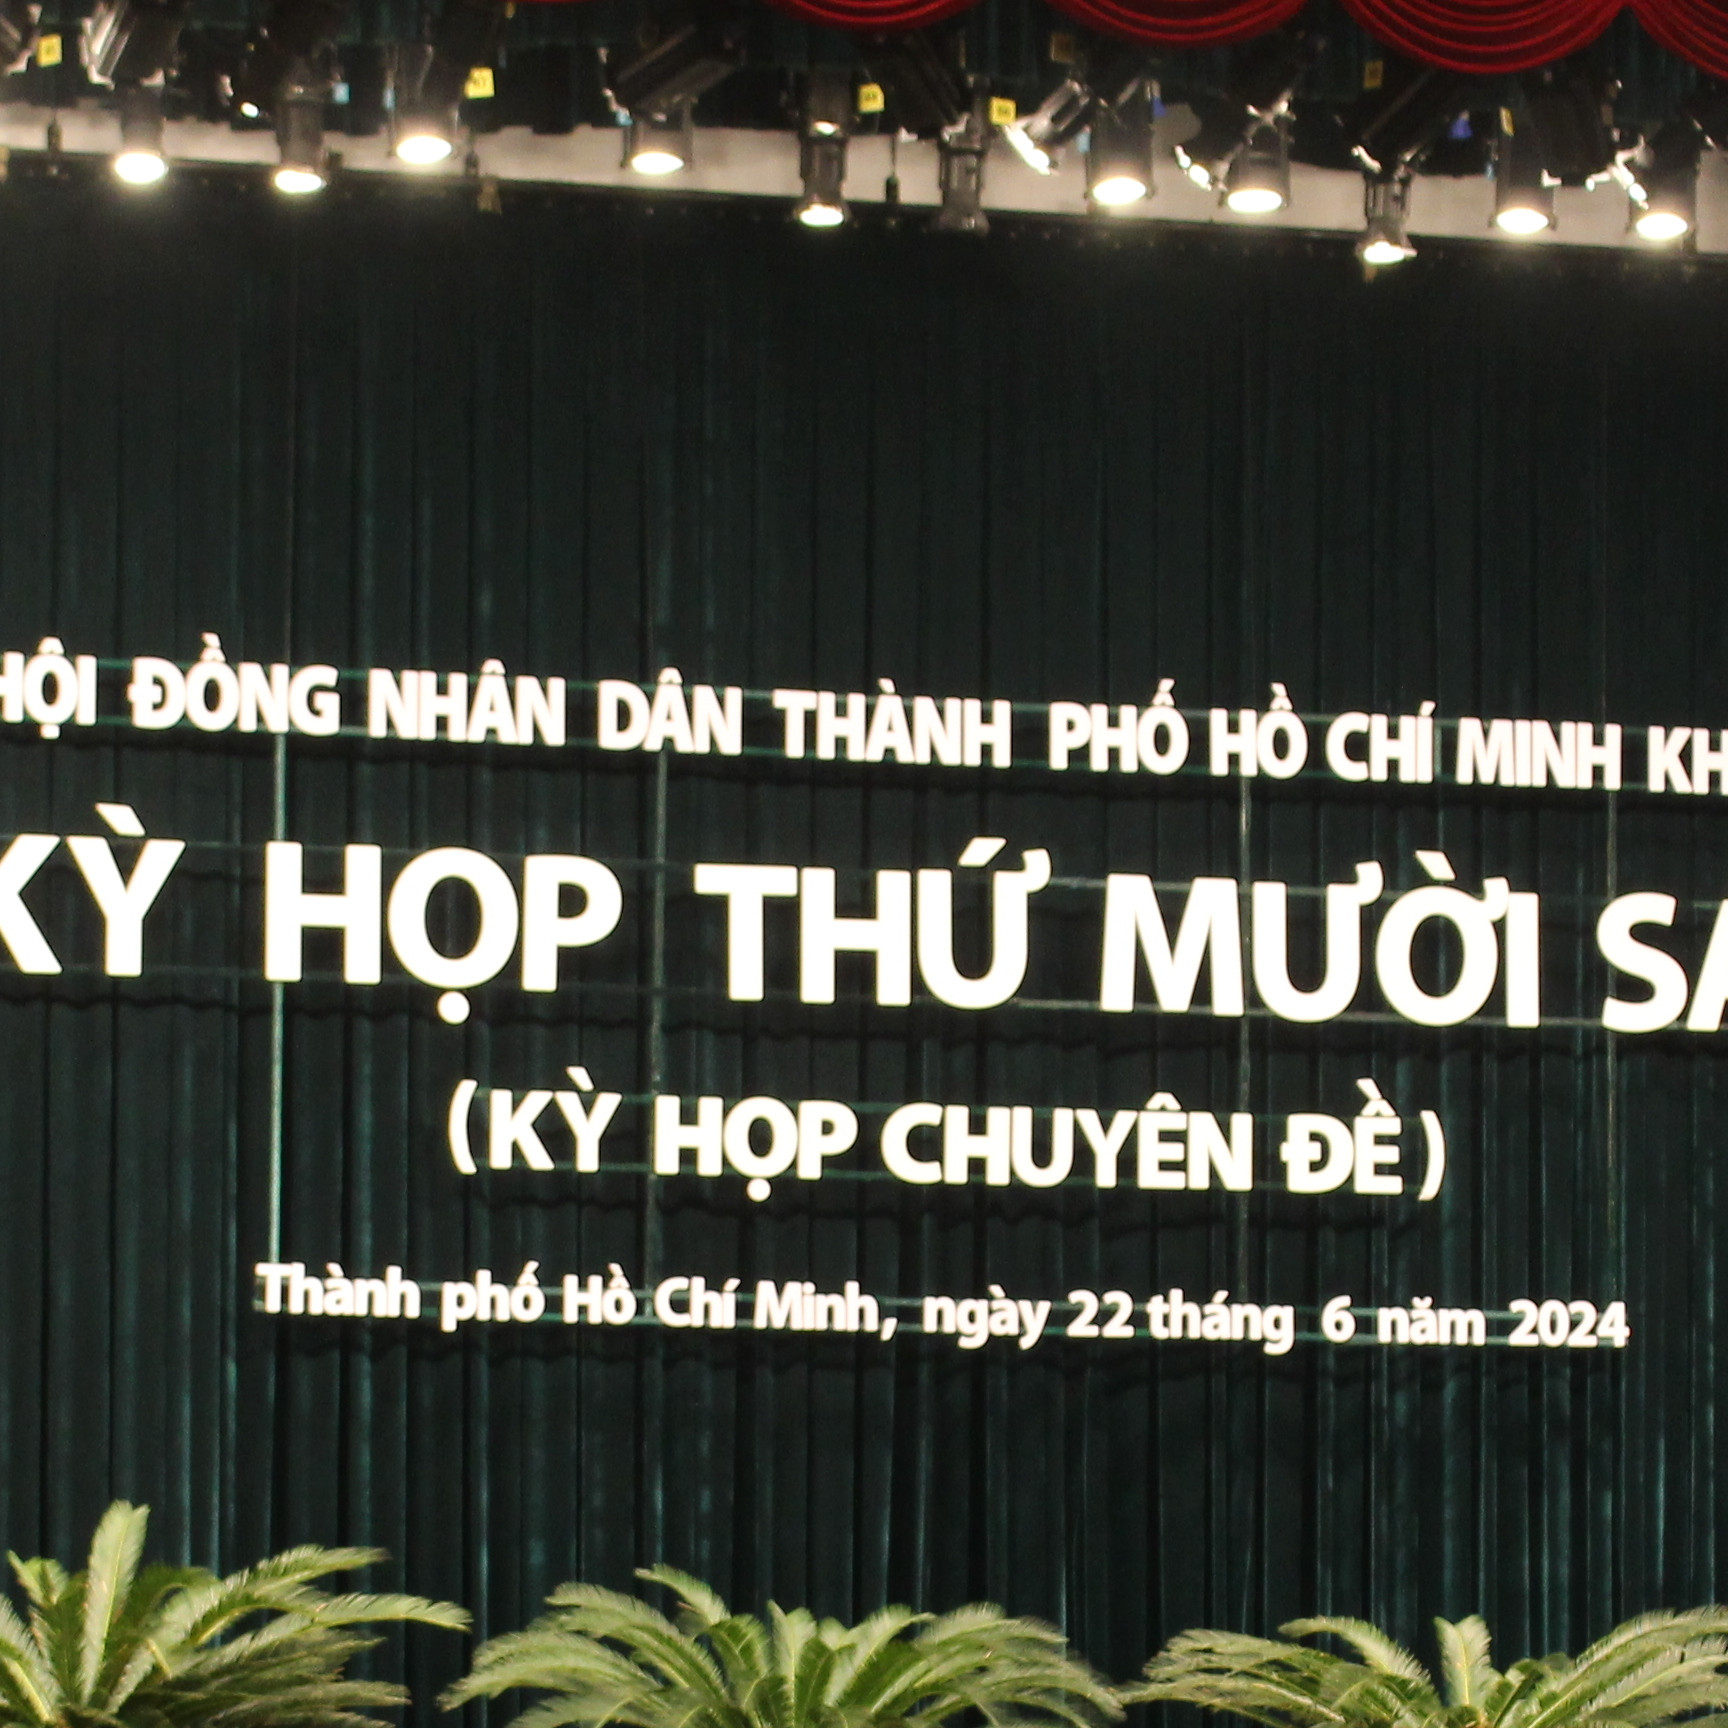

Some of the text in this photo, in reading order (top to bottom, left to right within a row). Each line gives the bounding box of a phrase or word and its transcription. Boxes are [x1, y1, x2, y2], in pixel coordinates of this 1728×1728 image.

[129, 632, 339, 736] ĐỒNG
[369, 658, 565, 746] NHÂN
[599, 667, 742, 754] DÂN
[773, 678, 1010, 768] THÀNH
[1050, 678, 1188, 776] PHỐ
[1210, 682, 1307, 780] HỒ
[1327, 700, 1435, 784] CHÍ
[1457, 716, 1621, 790] MINH
[266, 841, 621, 1023] HỌP
[695, 838, 1050, 1008] THỨ
[1101, 851, 1539, 1027] MƯỜI
[450, 1067, 1444, 1201] (KỲ HỌP CHUYÊN ĐỀ)
[256, 1261, 1630, 1355] Thành phố Hồ Chí Minh, ngày 22 tháng 6 năm 2024
